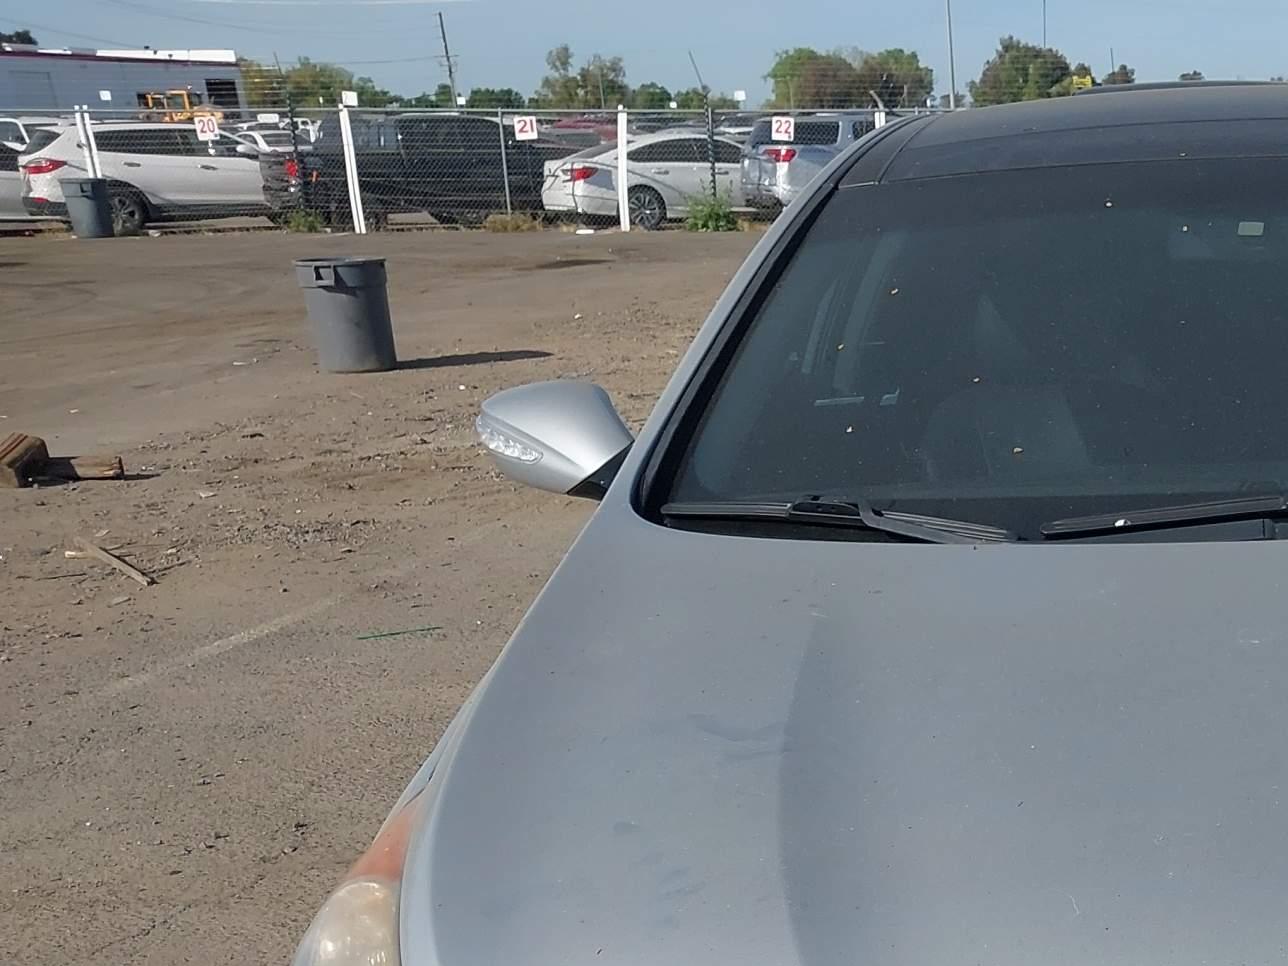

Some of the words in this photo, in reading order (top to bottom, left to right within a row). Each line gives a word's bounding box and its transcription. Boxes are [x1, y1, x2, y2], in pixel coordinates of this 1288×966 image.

[199, 118, 216, 134] 20
[517, 118, 535, 134] 21
[775, 119, 792, 135] 22
